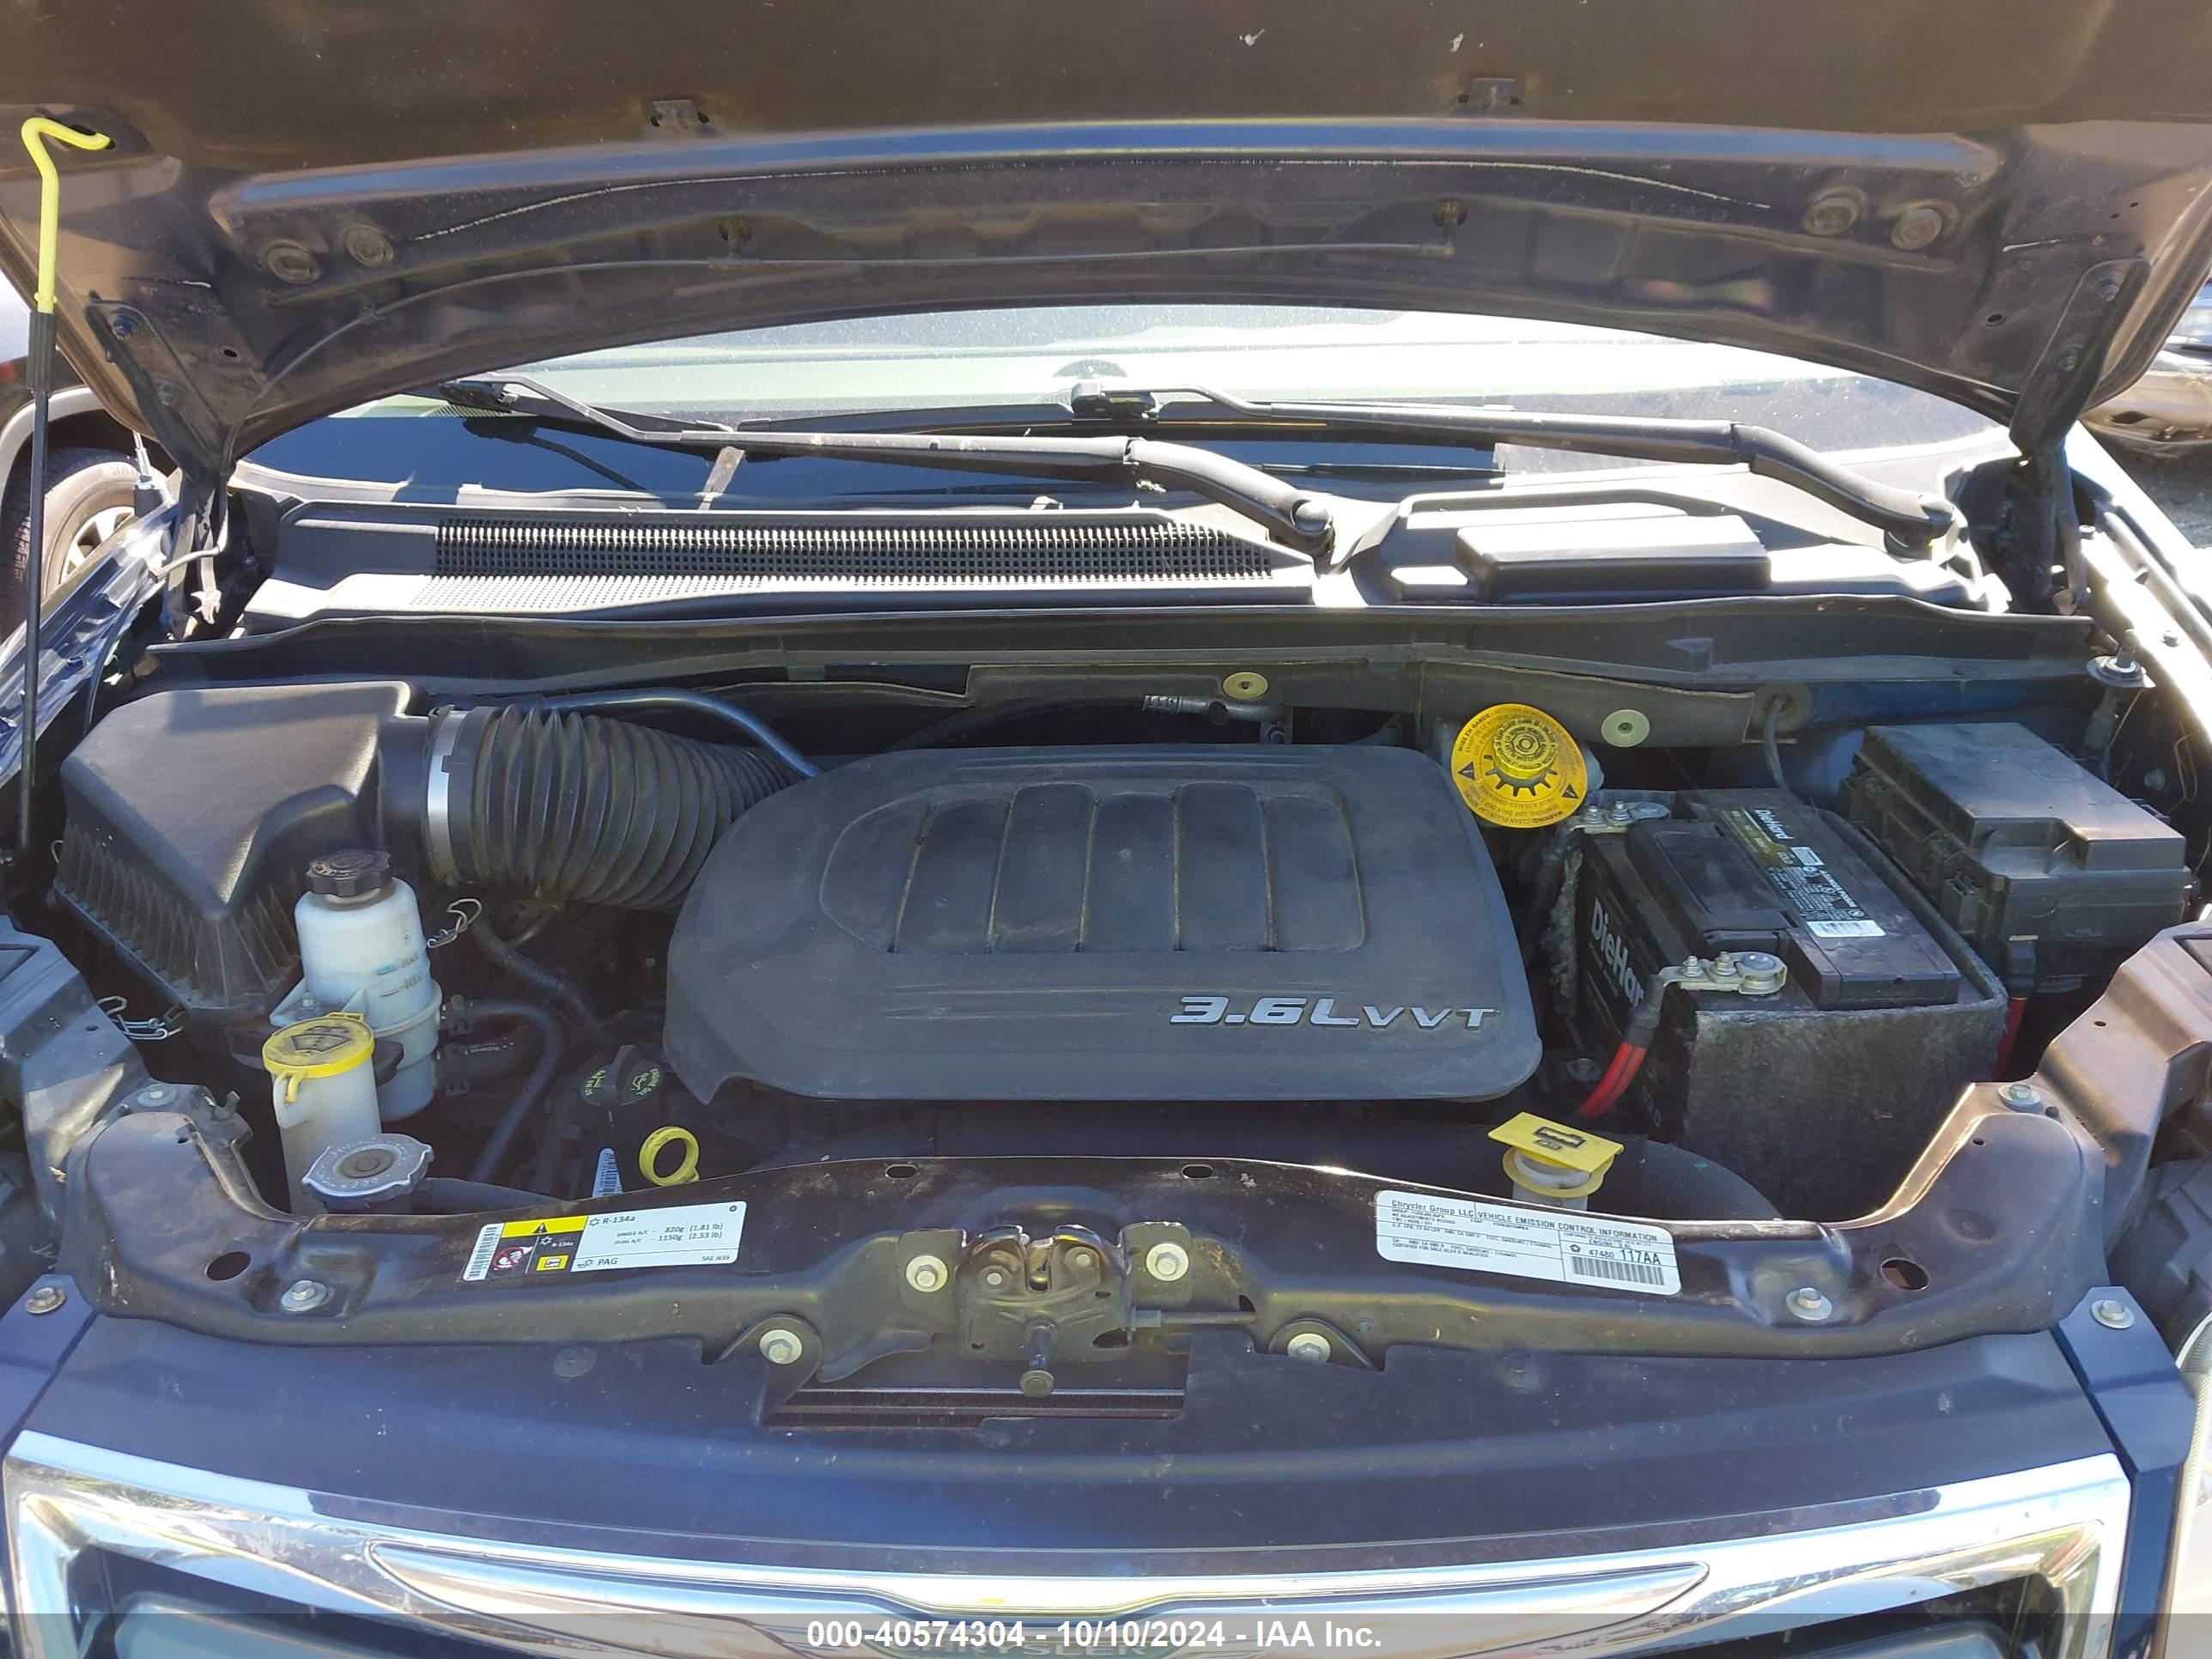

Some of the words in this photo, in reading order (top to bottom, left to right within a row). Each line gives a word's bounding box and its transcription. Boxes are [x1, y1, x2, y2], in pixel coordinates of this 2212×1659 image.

[1753, 809, 1796, 840] DieHard
[1590, 897, 1644, 1007] DieHar
[602, 1215, 635, 1224] R-134a
[1391, 1200, 1427, 1212] Chrysler
[1429, 1204, 1456, 1216] Group
[1458, 1208, 1474, 1218] LLC
[1478, 1211, 1513, 1223] VEHICLE
[1515, 1216, 1555, 1229] EMISSION
[1558, 1223, 1596, 1234] CONTROL
[1599, 1228, 1658, 1241] INFORMATION
[689, 1231, 709, 1240] (2.53
[1588, 1249, 1614, 1259] 47480
[1620, 1249, 1662, 1265] 117AA
